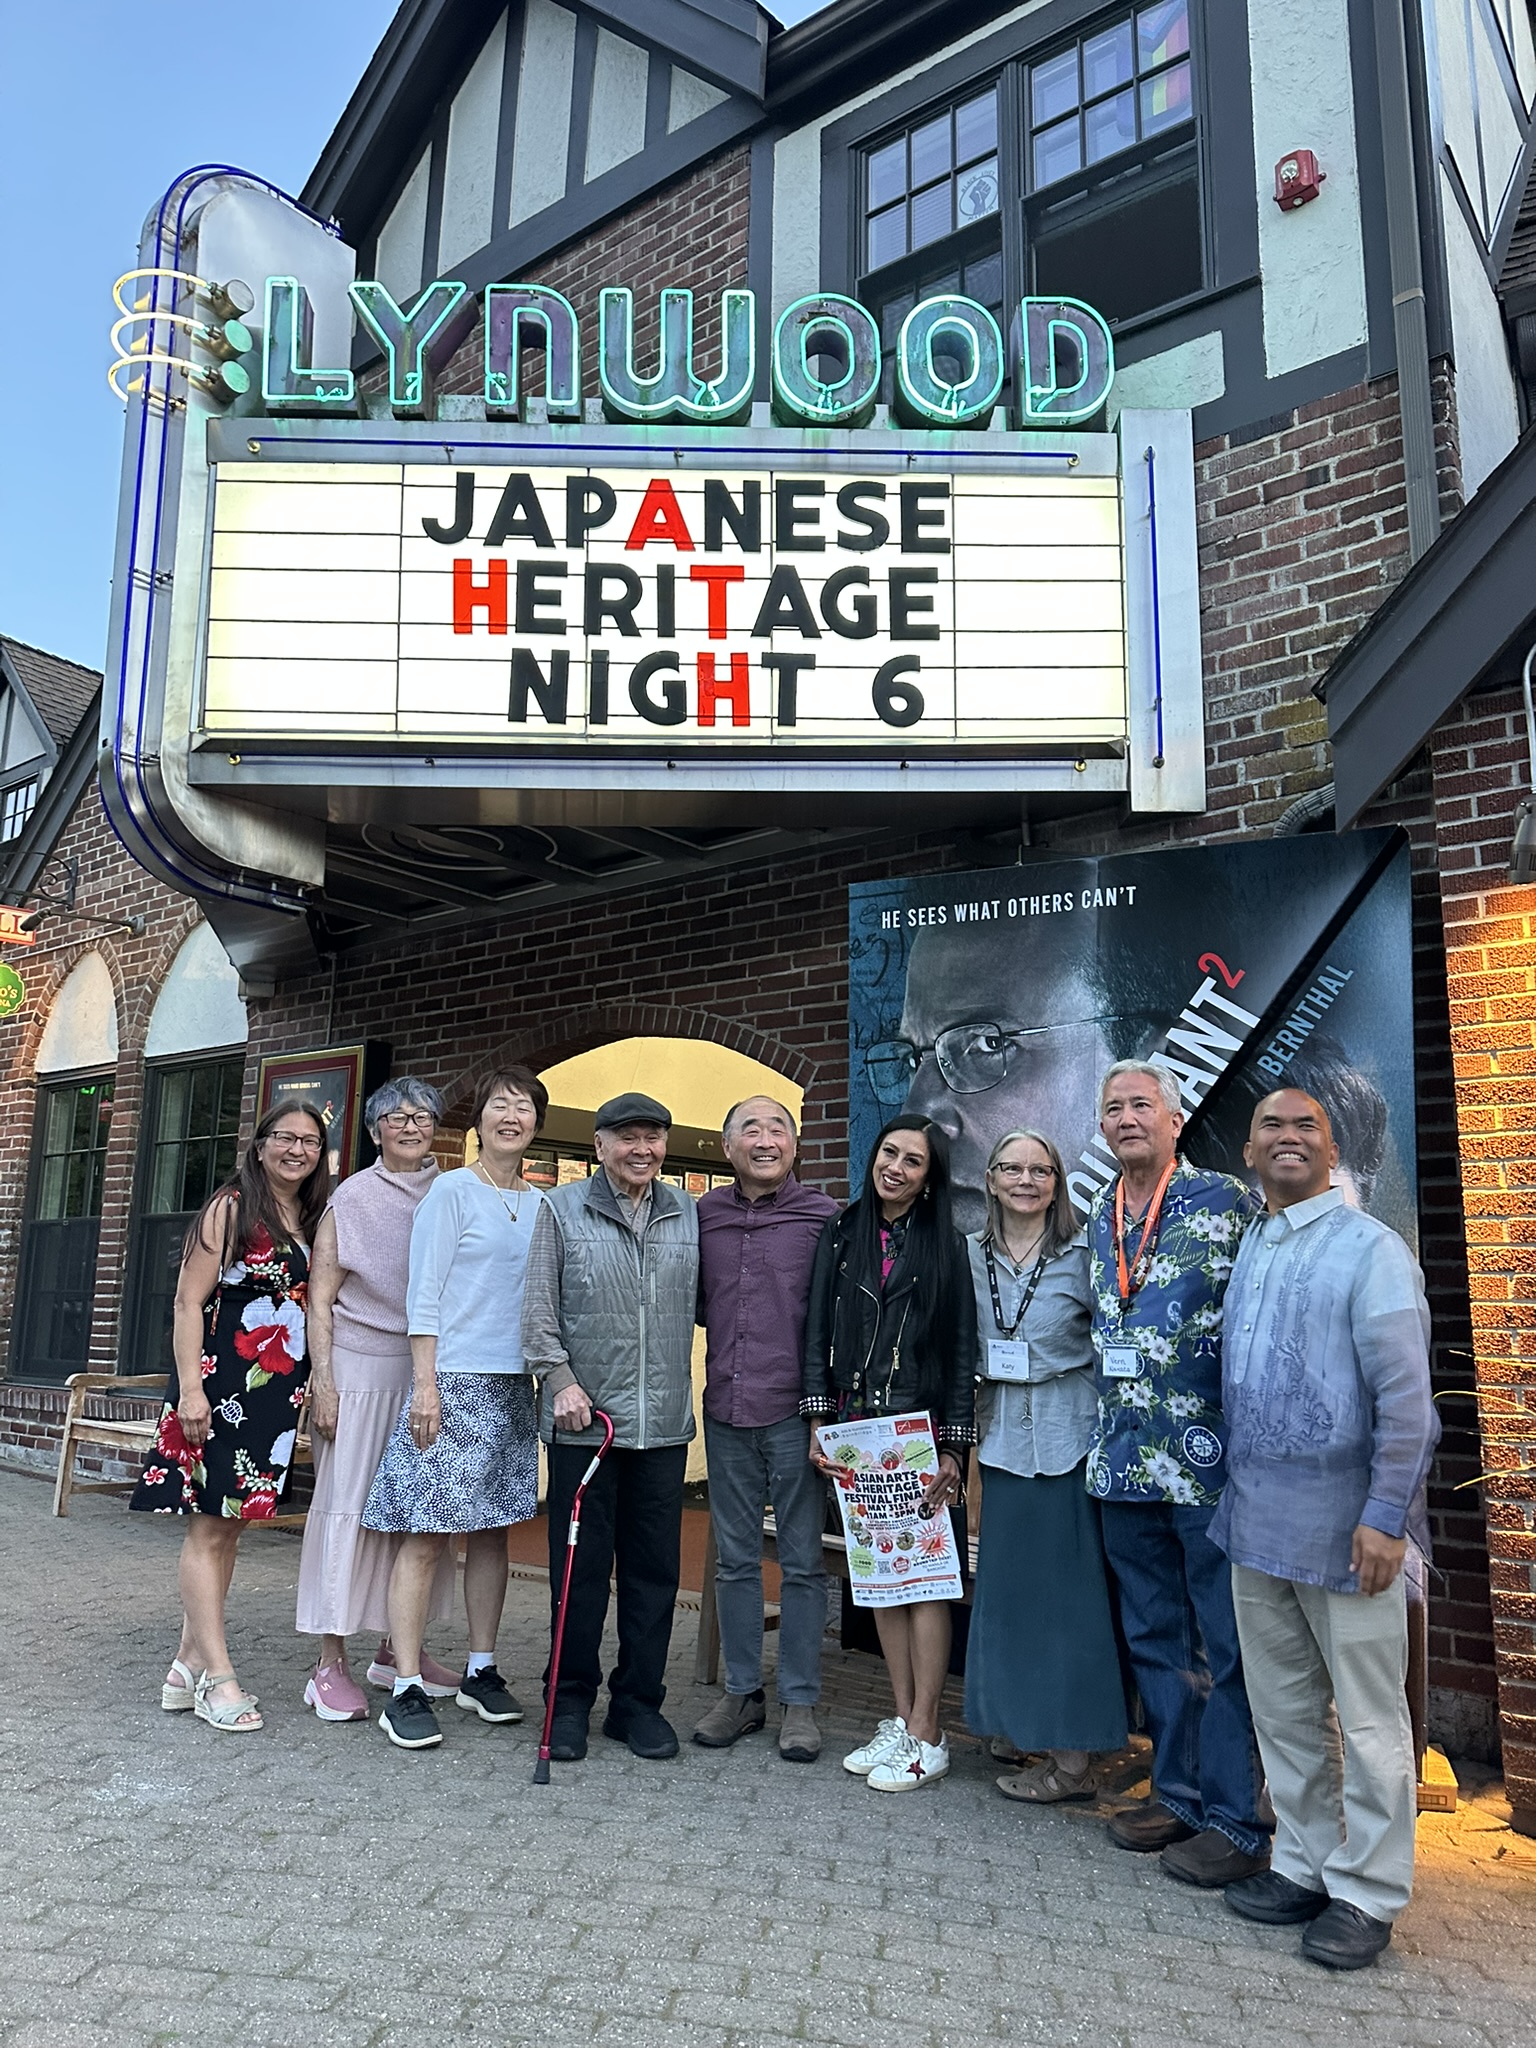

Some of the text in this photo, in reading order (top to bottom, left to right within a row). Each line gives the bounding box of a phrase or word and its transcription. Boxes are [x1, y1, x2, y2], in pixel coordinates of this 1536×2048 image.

[260, 276, 1116, 427] LYNWOOD
[422, 471, 952, 555] JAPANESE
[453, 558, 940, 641] HERITAGE
[507, 648, 925, 729] NIGHT 6
[881, 885, 1137, 930] HE SEES WHAT OTHERS CAN'T
[1197, 951, 1246, 990] 2
[1256, 964, 1355, 1077] BERNTHAL
[854, 1470, 918, 1484] ASIAN ARTS
[855, 1480, 920, 1494] & HERITAGE
[844, 1493, 894, 1504] FESTIVAL
[867, 1504, 887, 1512] MAY
[895, 1508, 916, 1519] 5PM
